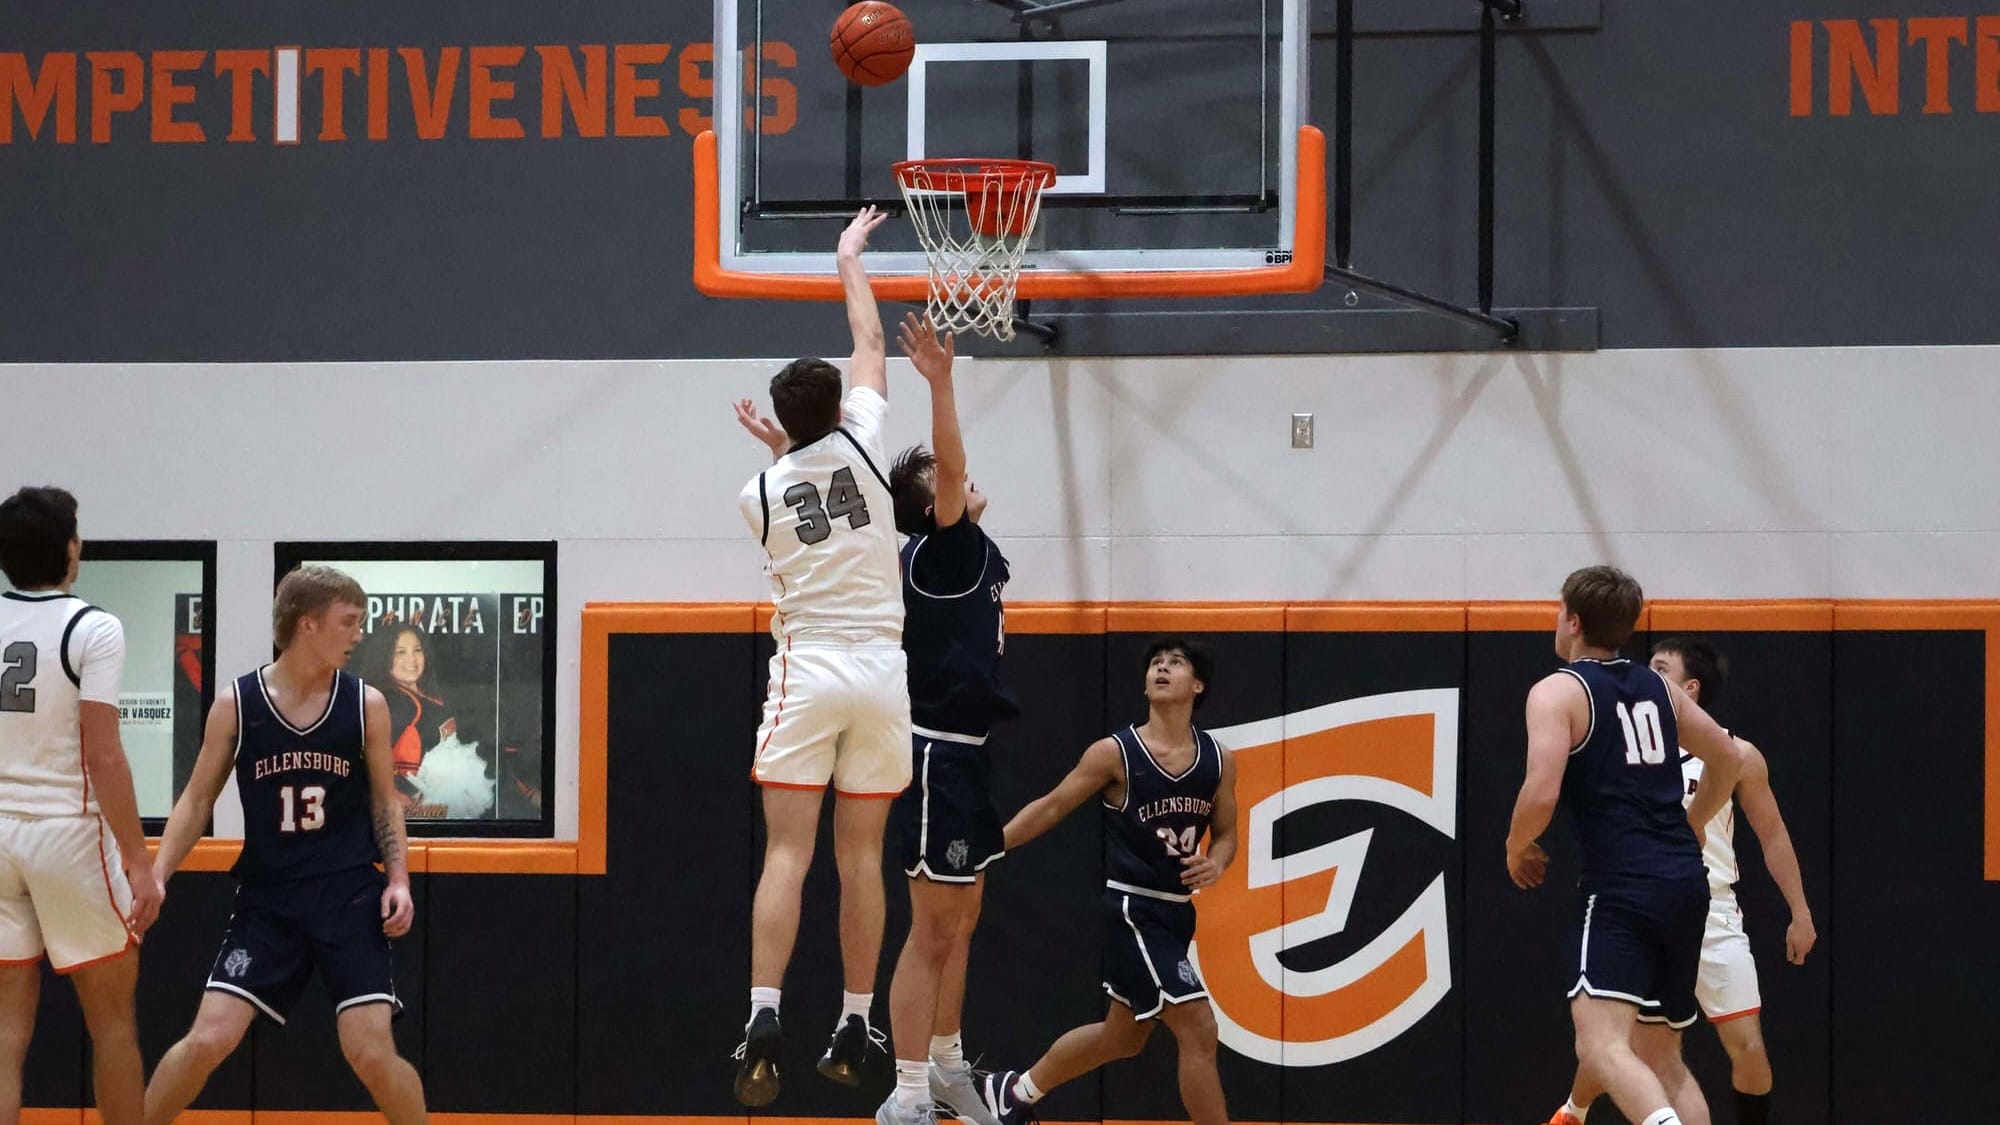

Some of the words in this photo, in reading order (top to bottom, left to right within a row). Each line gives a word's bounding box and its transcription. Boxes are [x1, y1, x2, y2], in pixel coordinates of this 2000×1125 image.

[783, 465, 871, 545] 34
[132, 707, 171, 720] VASQUEZ
[1616, 700, 1666, 765] 10
[255, 752, 350, 780] ELLENSBURG
[280, 786, 326, 831] 13
[1138, 796, 1212, 823] ELLENSBURG
[1156, 825, 1198, 857] 24
